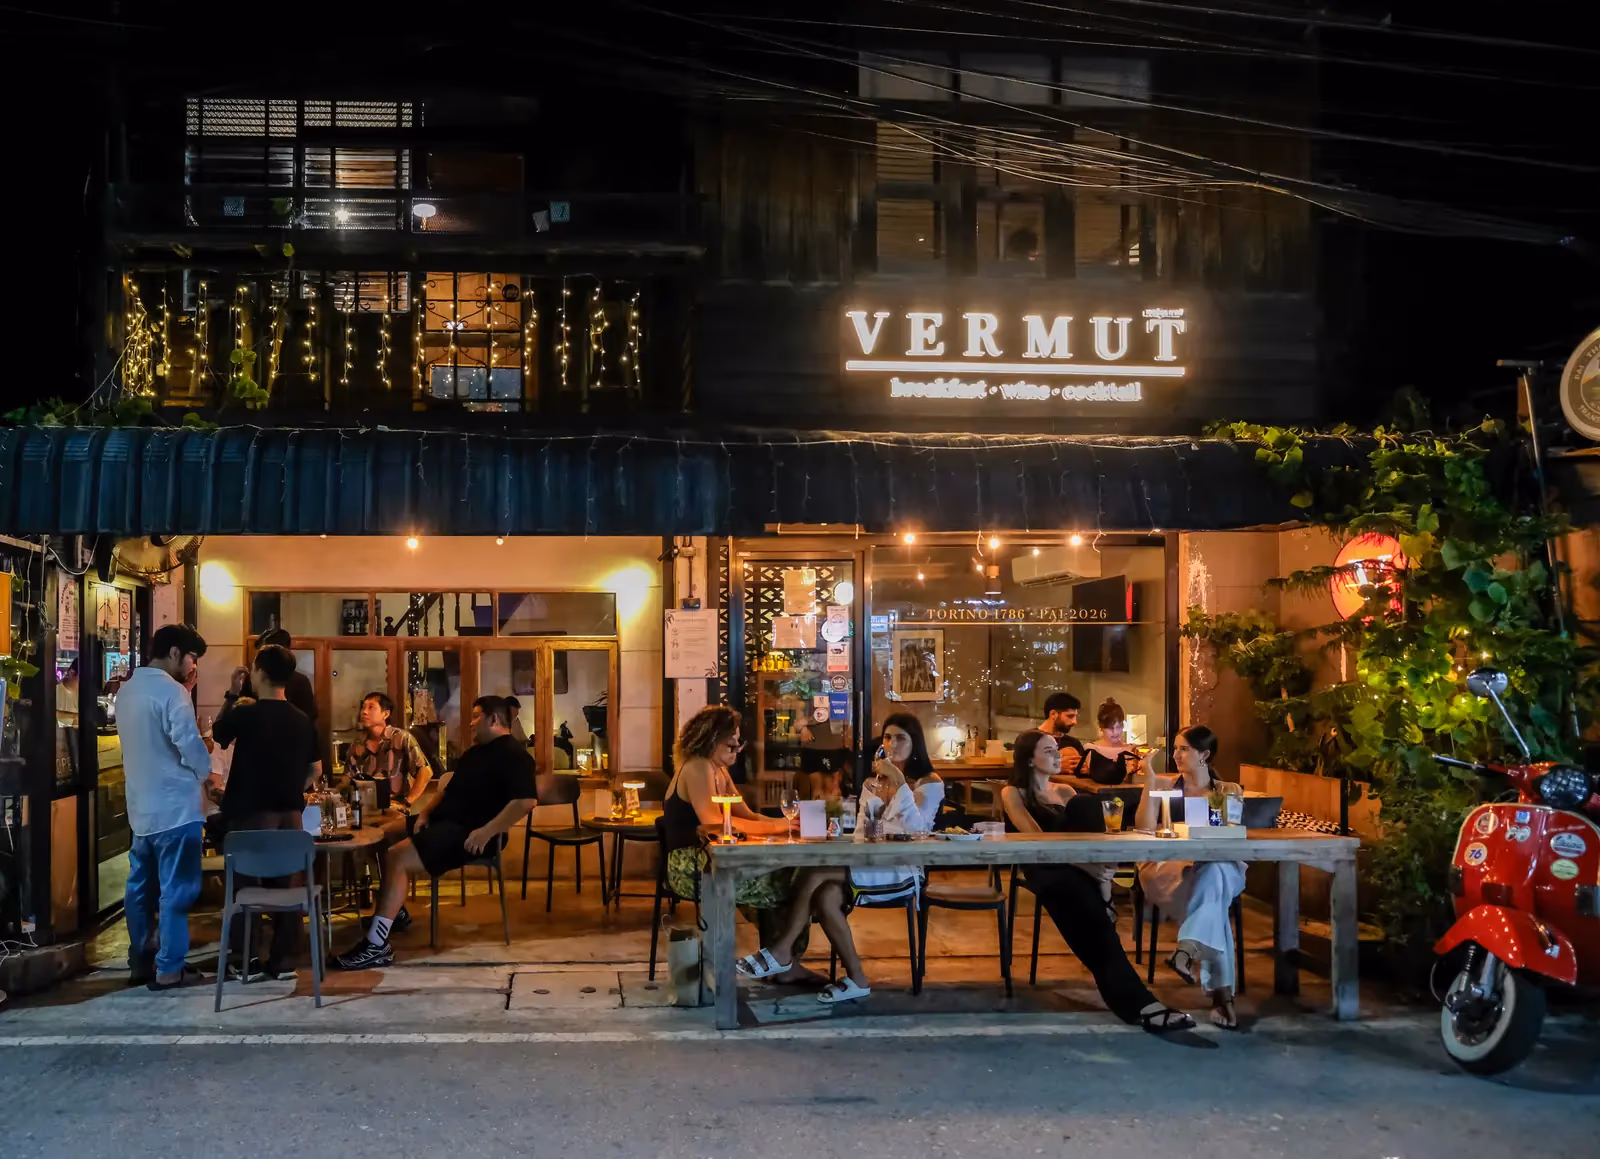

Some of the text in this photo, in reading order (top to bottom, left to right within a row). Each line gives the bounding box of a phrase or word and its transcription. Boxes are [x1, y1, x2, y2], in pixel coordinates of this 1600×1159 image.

[846, 310, 1186, 361] VERMUT
[926, 608, 1107, 620] TORINO 1786 PAI 2026
[1468, 848, 1483, 860] 76
